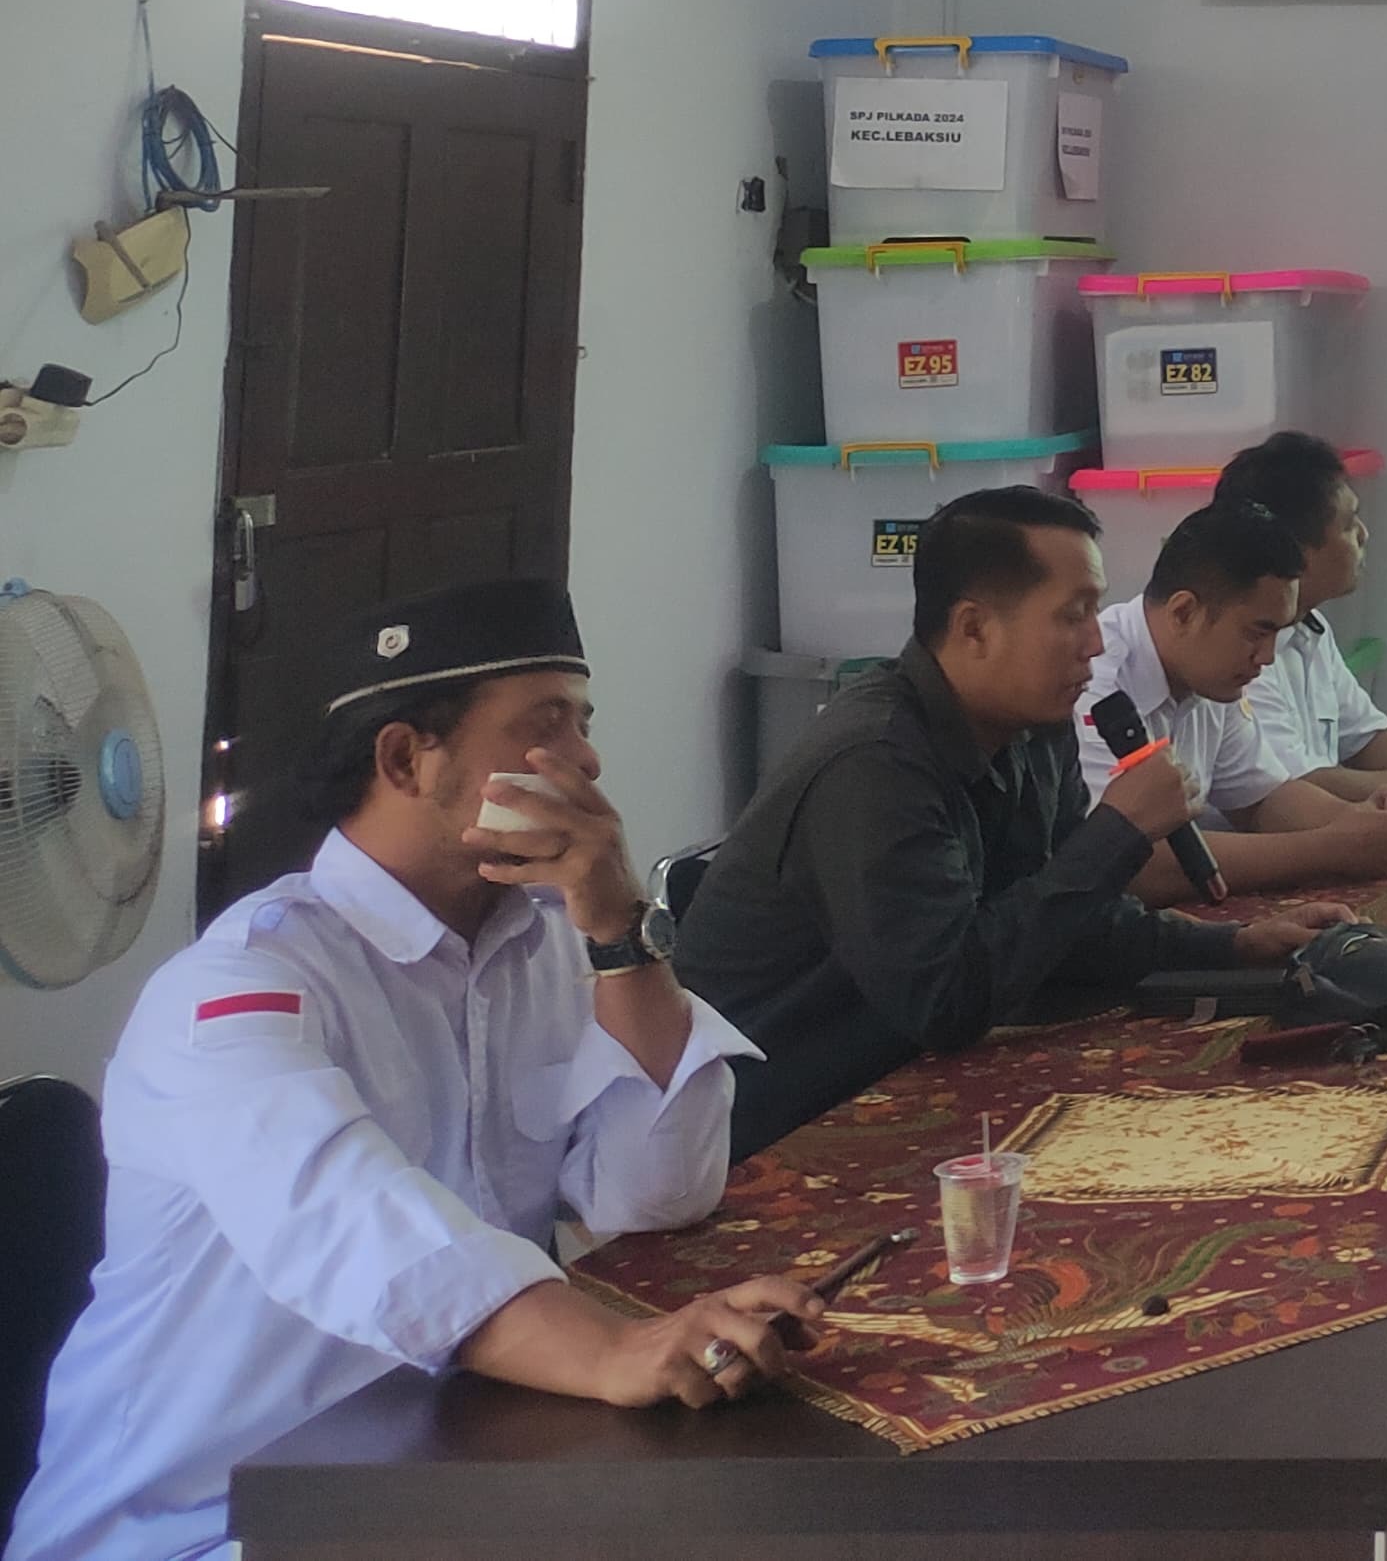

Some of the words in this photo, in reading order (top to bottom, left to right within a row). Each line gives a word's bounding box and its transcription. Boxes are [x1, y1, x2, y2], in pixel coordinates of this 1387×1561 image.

[850, 111, 873, 121] SPJ
[877, 111, 930, 122] PILKADA
[934, 113, 964, 123] 2024
[850, 130, 962, 144] KEC.LEBAKSIU
[904, 356, 927, 375] EZ
[929, 355, 953, 374] 95
[1166, 363, 1188, 382] EZ
[1191, 363, 1212, 382] 82
[876, 534, 899, 554] EZ
